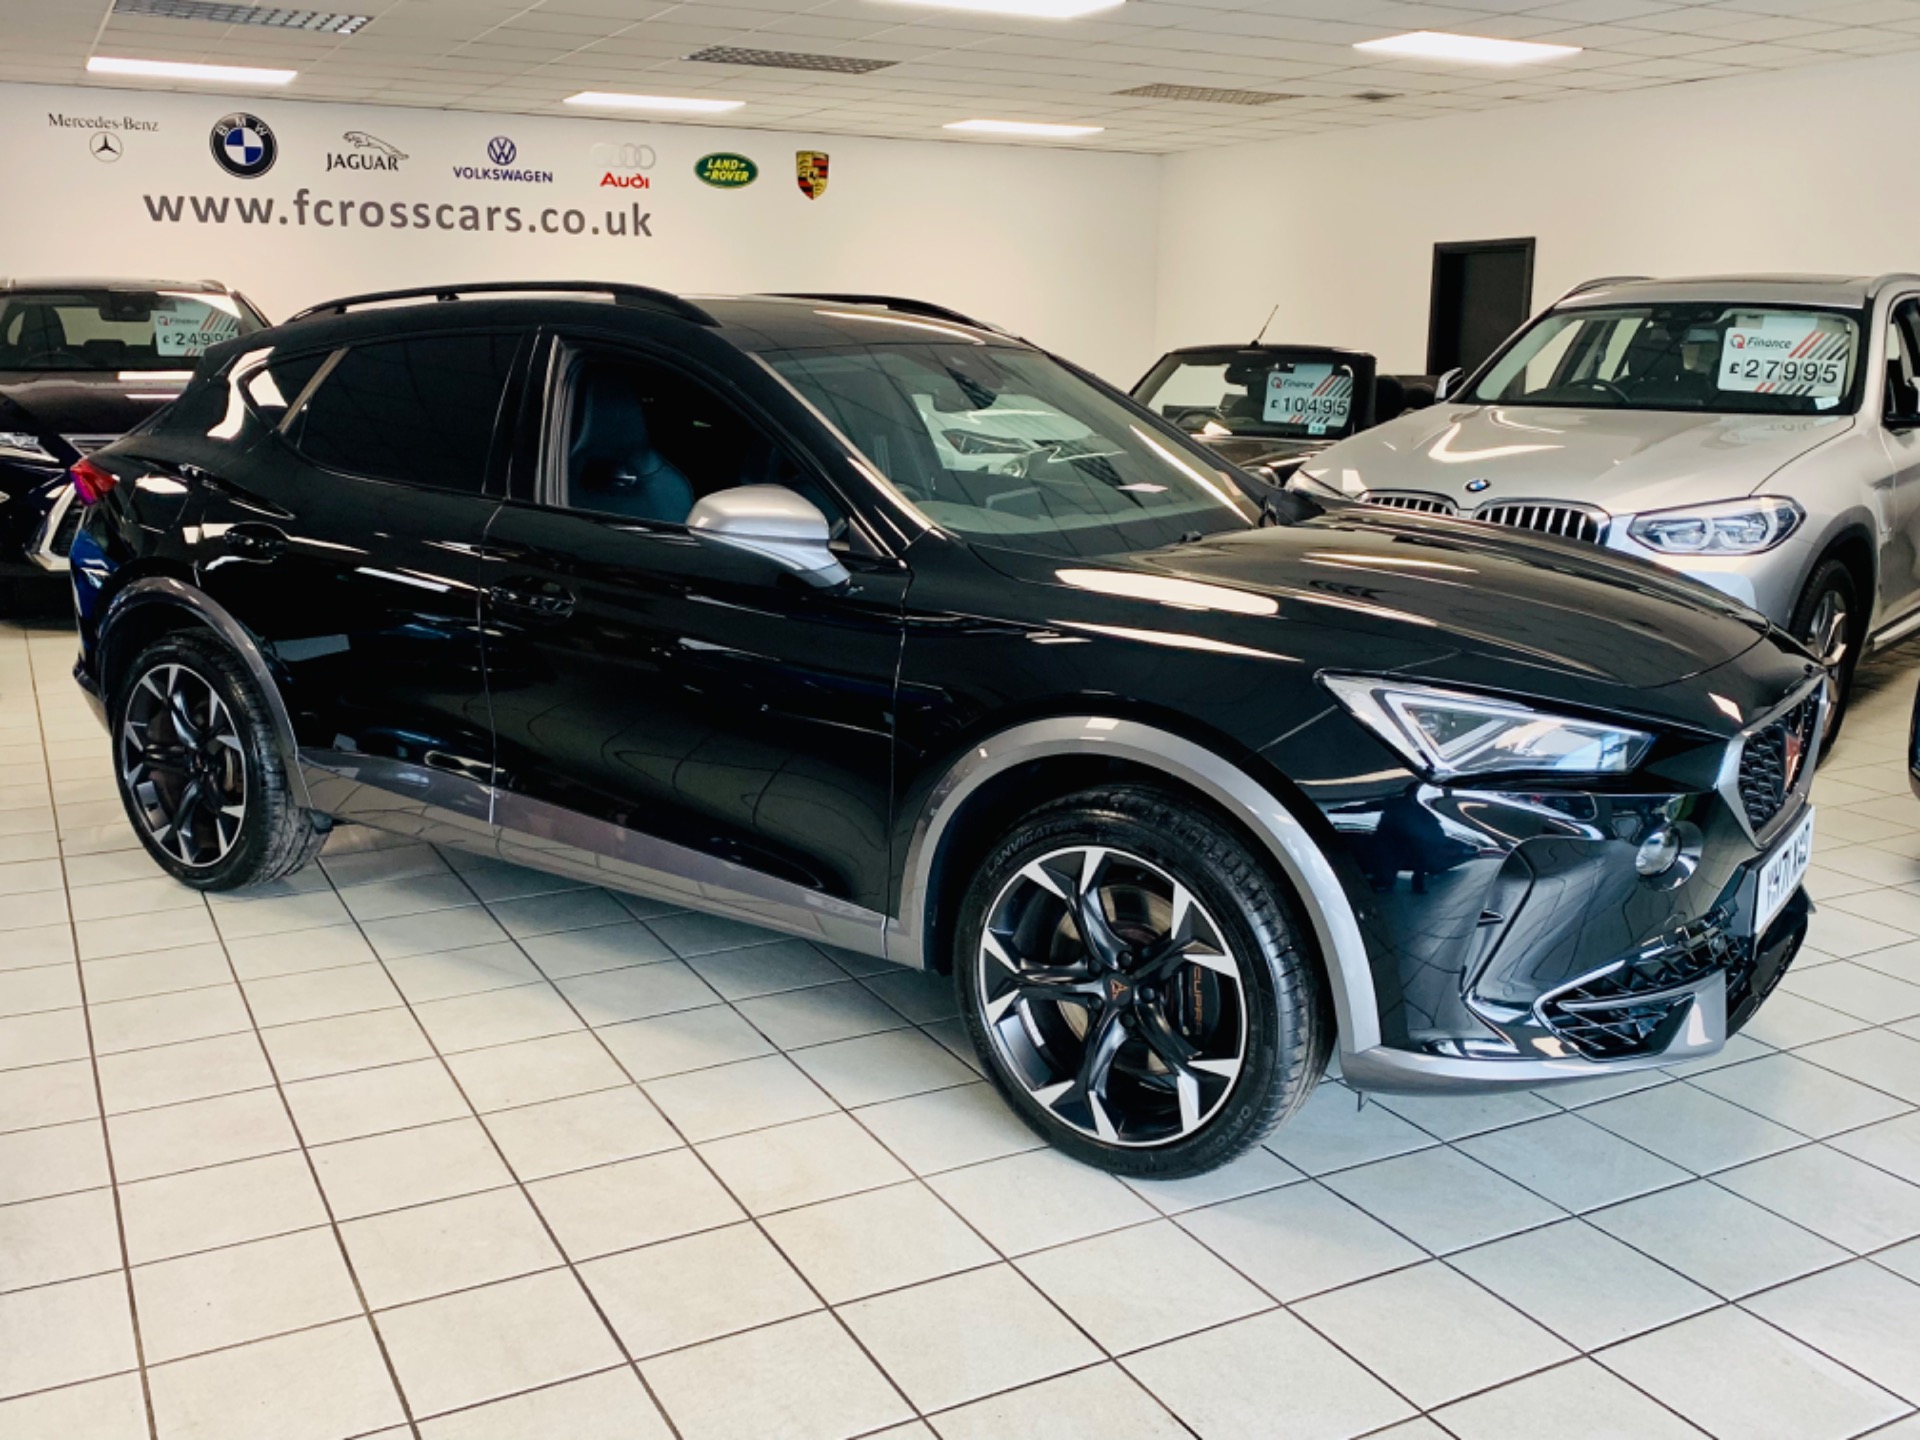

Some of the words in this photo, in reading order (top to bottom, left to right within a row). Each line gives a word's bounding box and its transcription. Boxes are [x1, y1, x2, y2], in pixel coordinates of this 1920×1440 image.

[48, 113, 160, 132] Mercedes-Benz
[326, 152, 398, 172] JAGUAR
[707, 158, 739, 170] LAND
[453, 167, 553, 183] VOLKSWAGEN
[600, 172, 650, 189] Audi
[710, 169, 750, 182] ROVER
[143, 188, 653, 237] www.fcrosscars.co.uk
[1747, 336, 1792, 350] Finance
[1284, 378, 1315, 390] Finance
